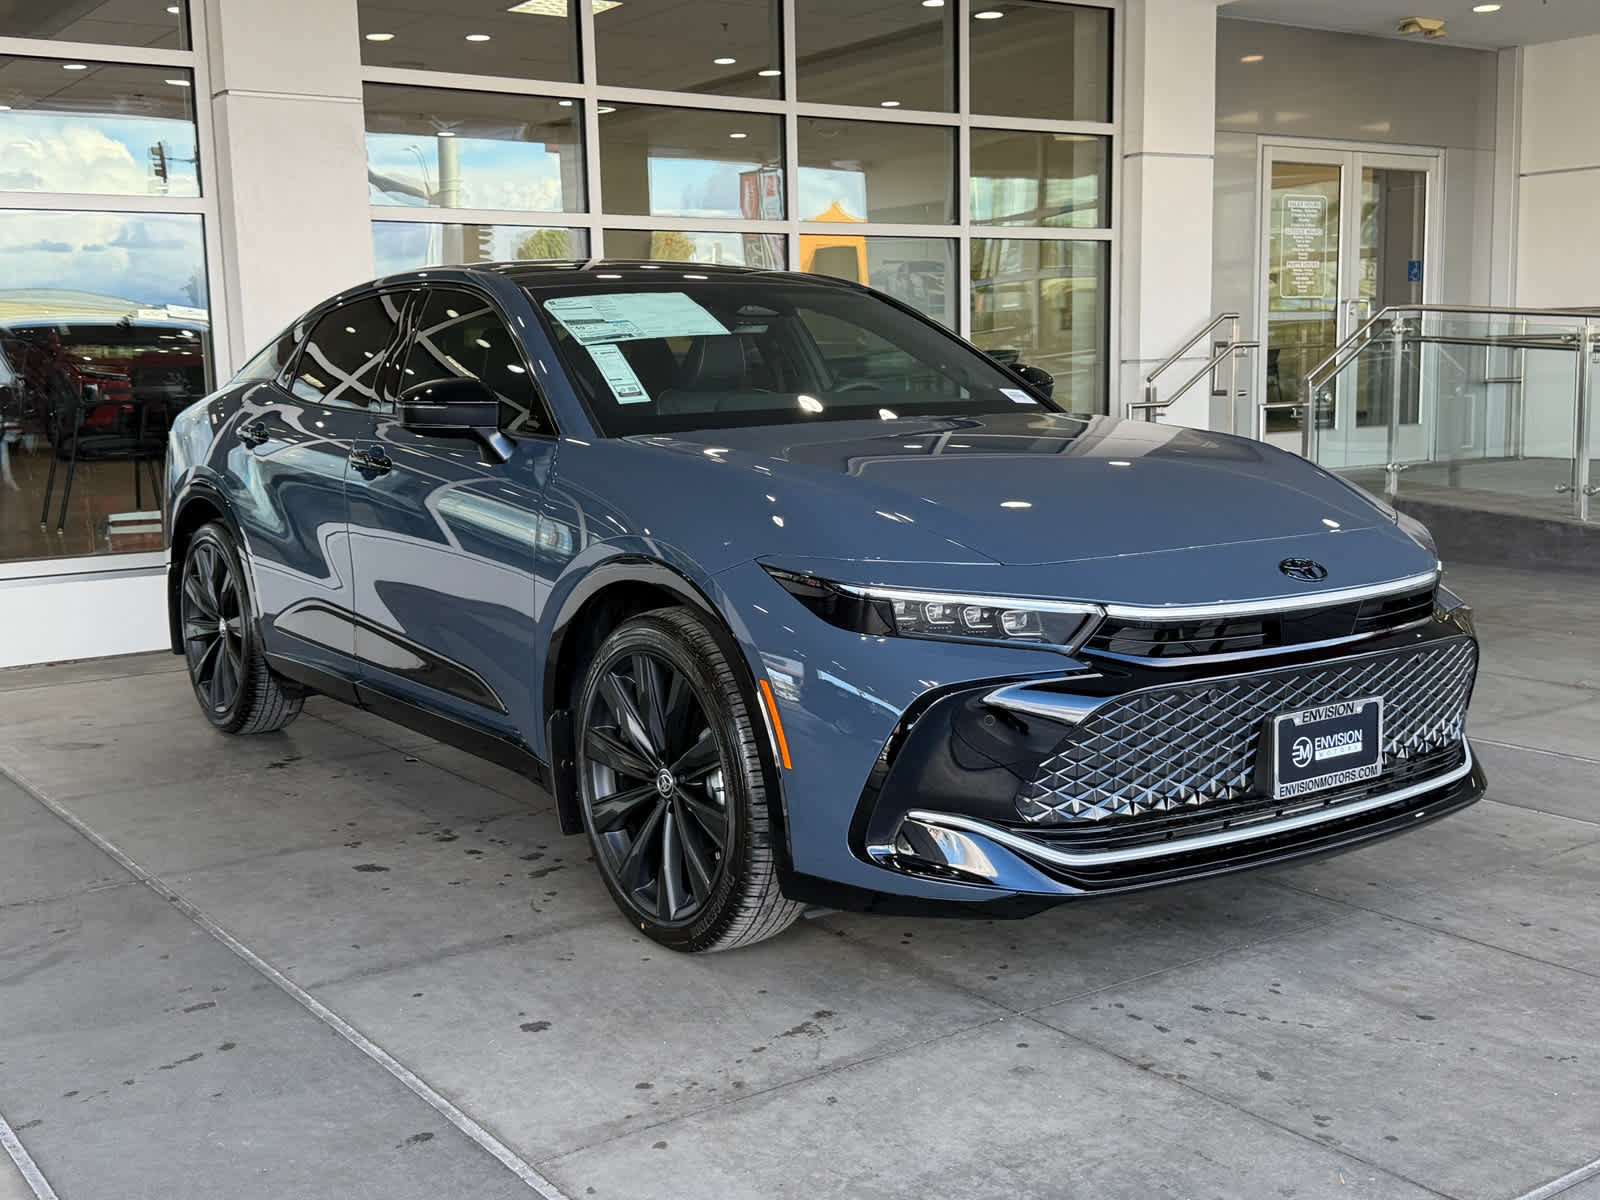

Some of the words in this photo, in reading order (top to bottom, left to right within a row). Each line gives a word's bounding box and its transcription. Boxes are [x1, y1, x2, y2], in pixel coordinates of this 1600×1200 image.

[1302, 703, 1355, 723] ENVISION
[1315, 729, 1363, 751] ENVISION
[1279, 766, 1378, 798] ENVISIONMOTORS.COM
